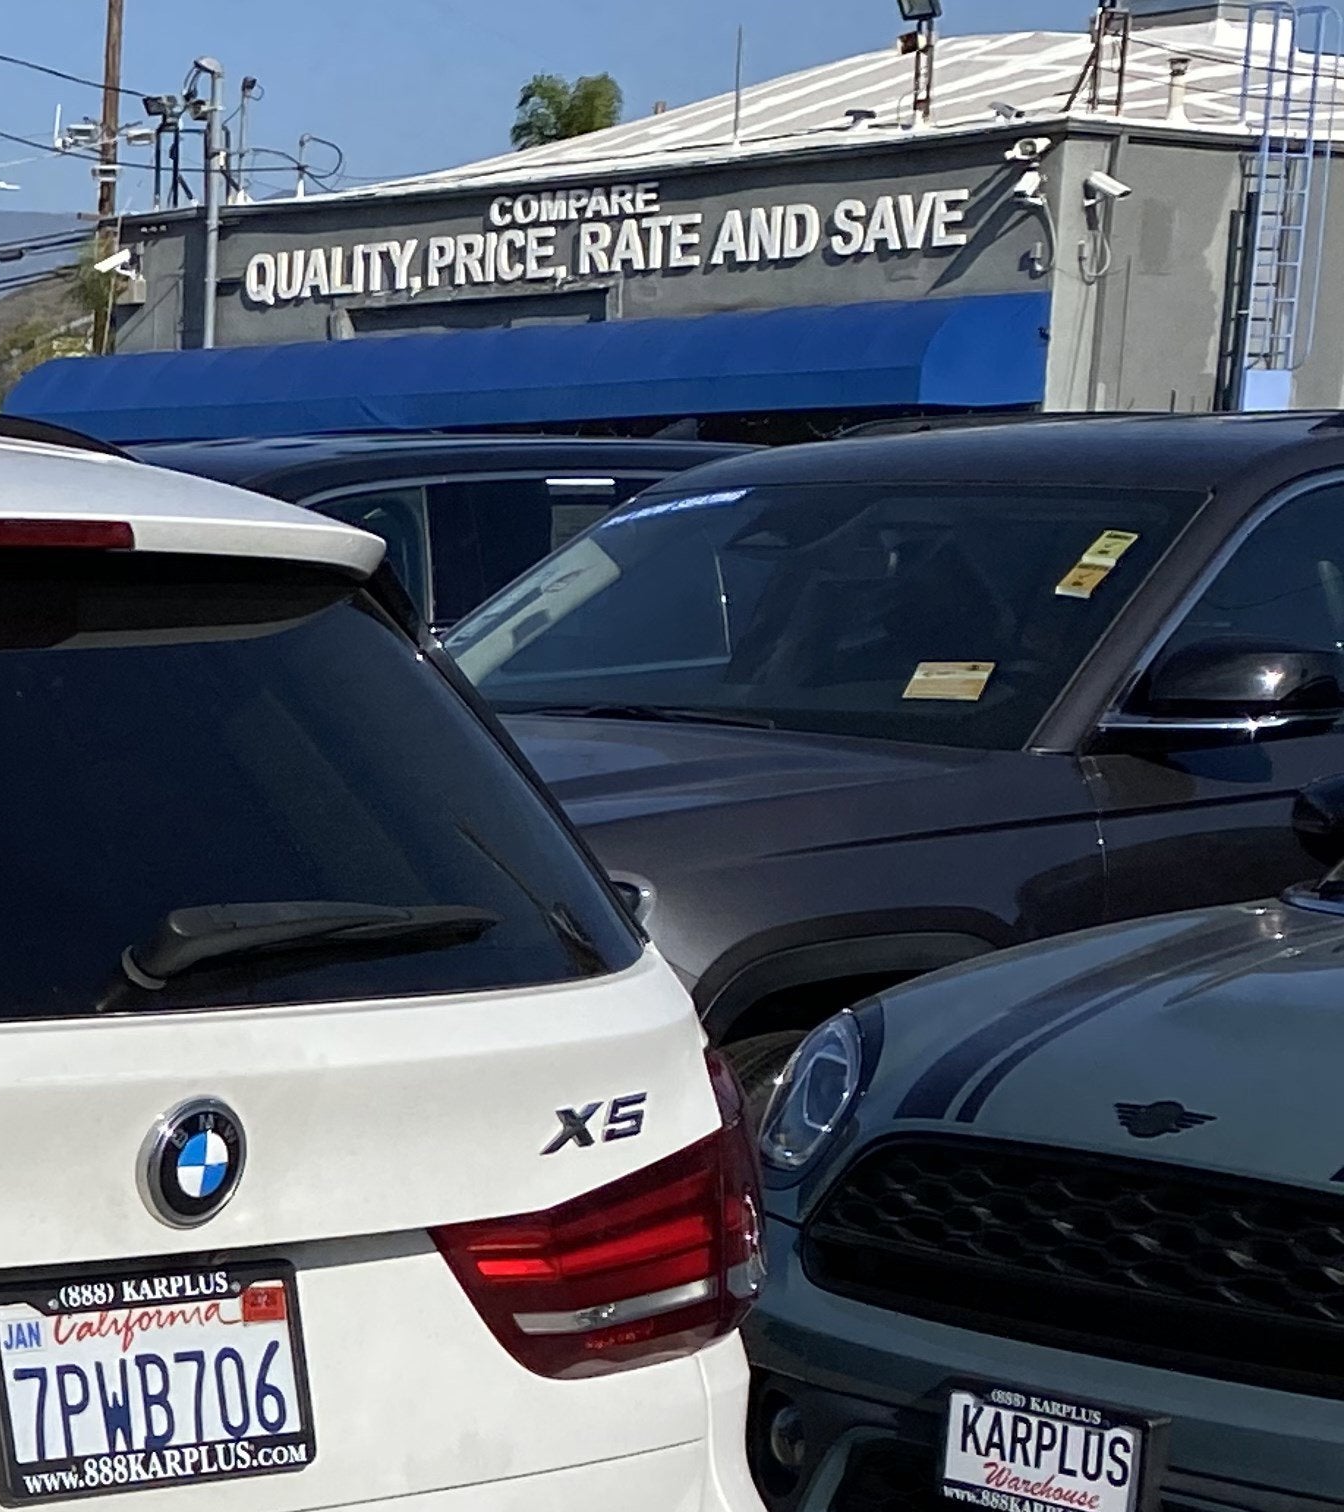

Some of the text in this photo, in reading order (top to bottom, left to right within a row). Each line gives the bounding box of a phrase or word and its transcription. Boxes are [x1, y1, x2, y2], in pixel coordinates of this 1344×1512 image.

[490, 182, 660, 227] COMPARE
[245, 189, 970, 306] QUALITY, PRICE, RATE AND SAVE
[172, 1113, 238, 1150] BMW
[540, 1091, 649, 1156] X5
[59, 1271, 229, 1309] (888) KARPLUS
[3, 1321, 42, 1350] JAN
[53, 1301, 241, 1352] California
[13, 1340, 288, 1461] 7PWB706
[1029, 1396, 1102, 1425] KARPLUS
[961, 1403, 1131, 1487] KARPLUS
[983, 1461, 1100, 1510] Warehouse
